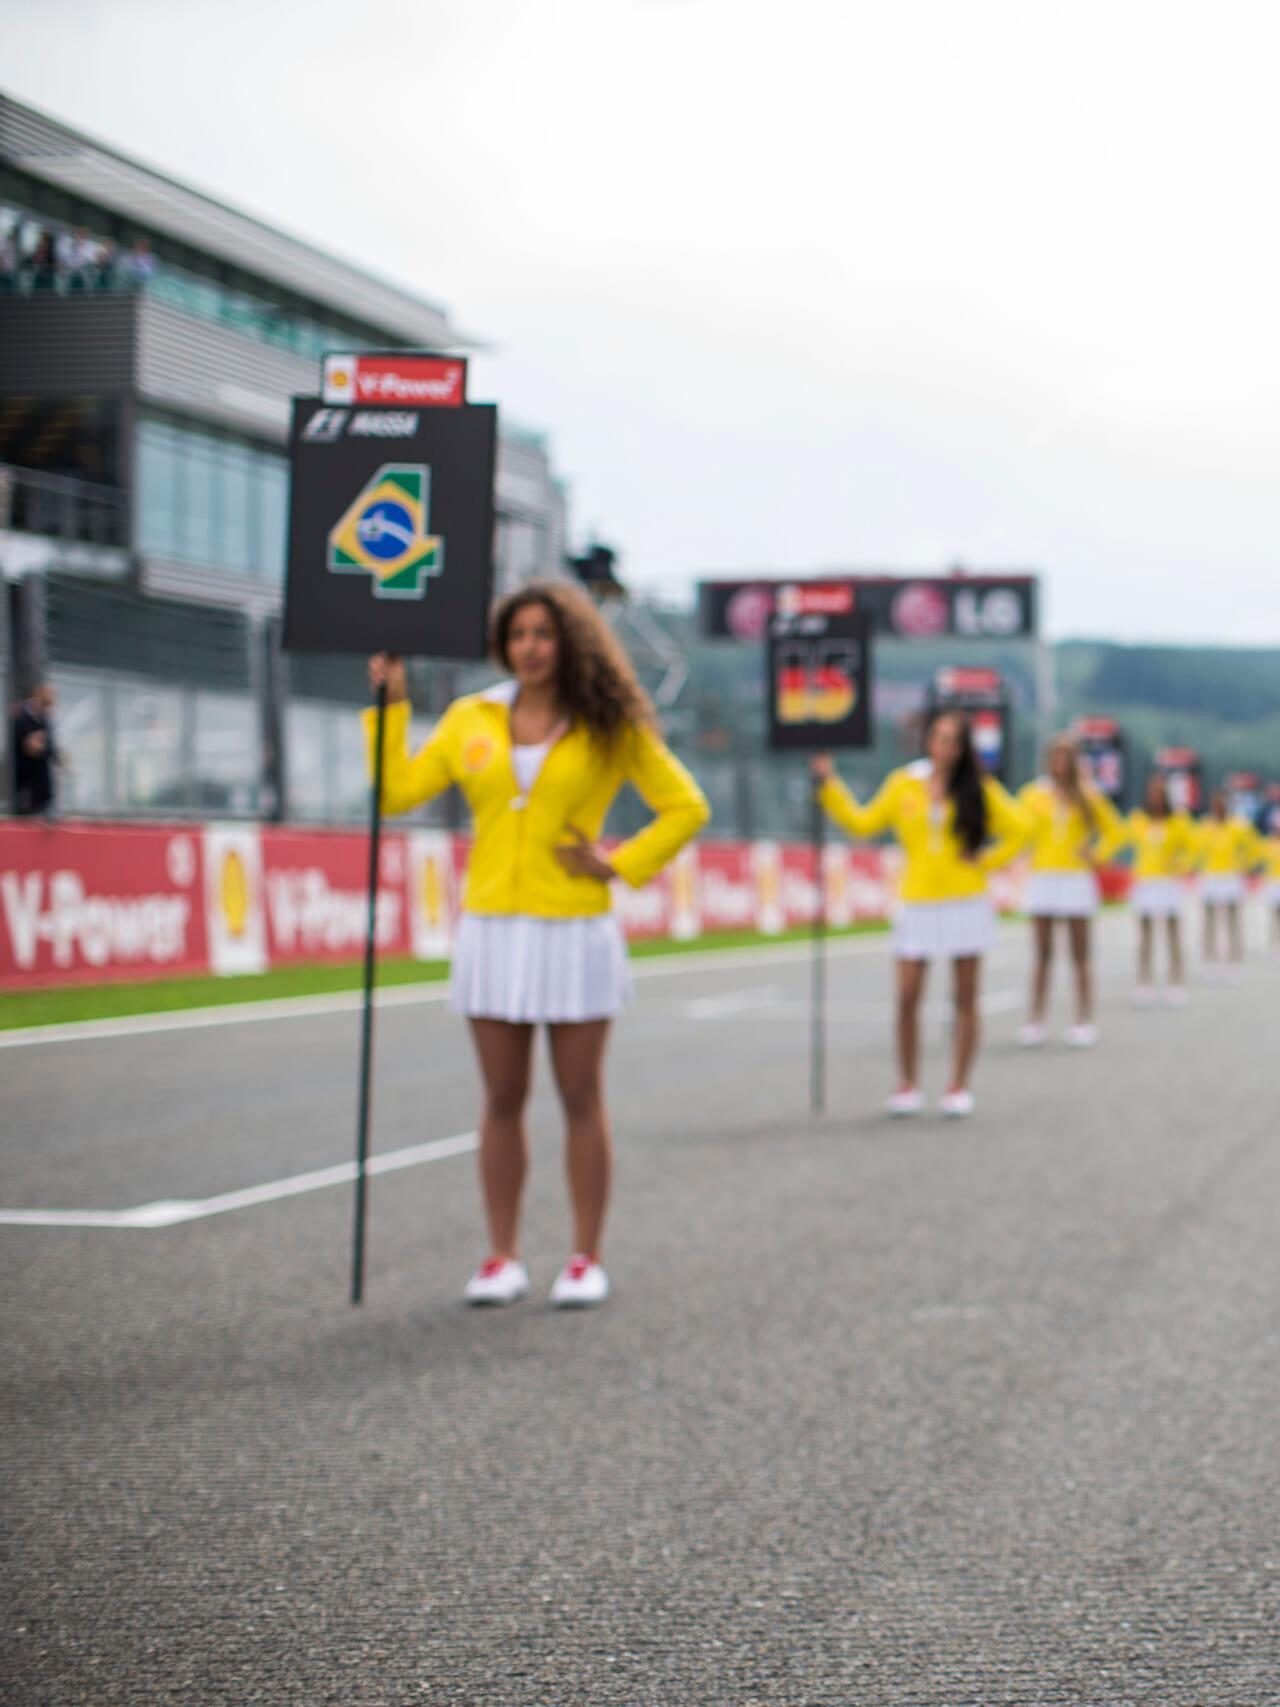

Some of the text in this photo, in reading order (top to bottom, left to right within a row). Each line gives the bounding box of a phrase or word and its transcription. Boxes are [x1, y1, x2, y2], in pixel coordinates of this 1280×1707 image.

[357, 372, 454, 398] V-Power
[349, 411, 419, 438] MASSA
[327, 463, 445, 600] 4
[954, 589, 1022, 635] LG
[2, 869, 188, 971] V-Power
